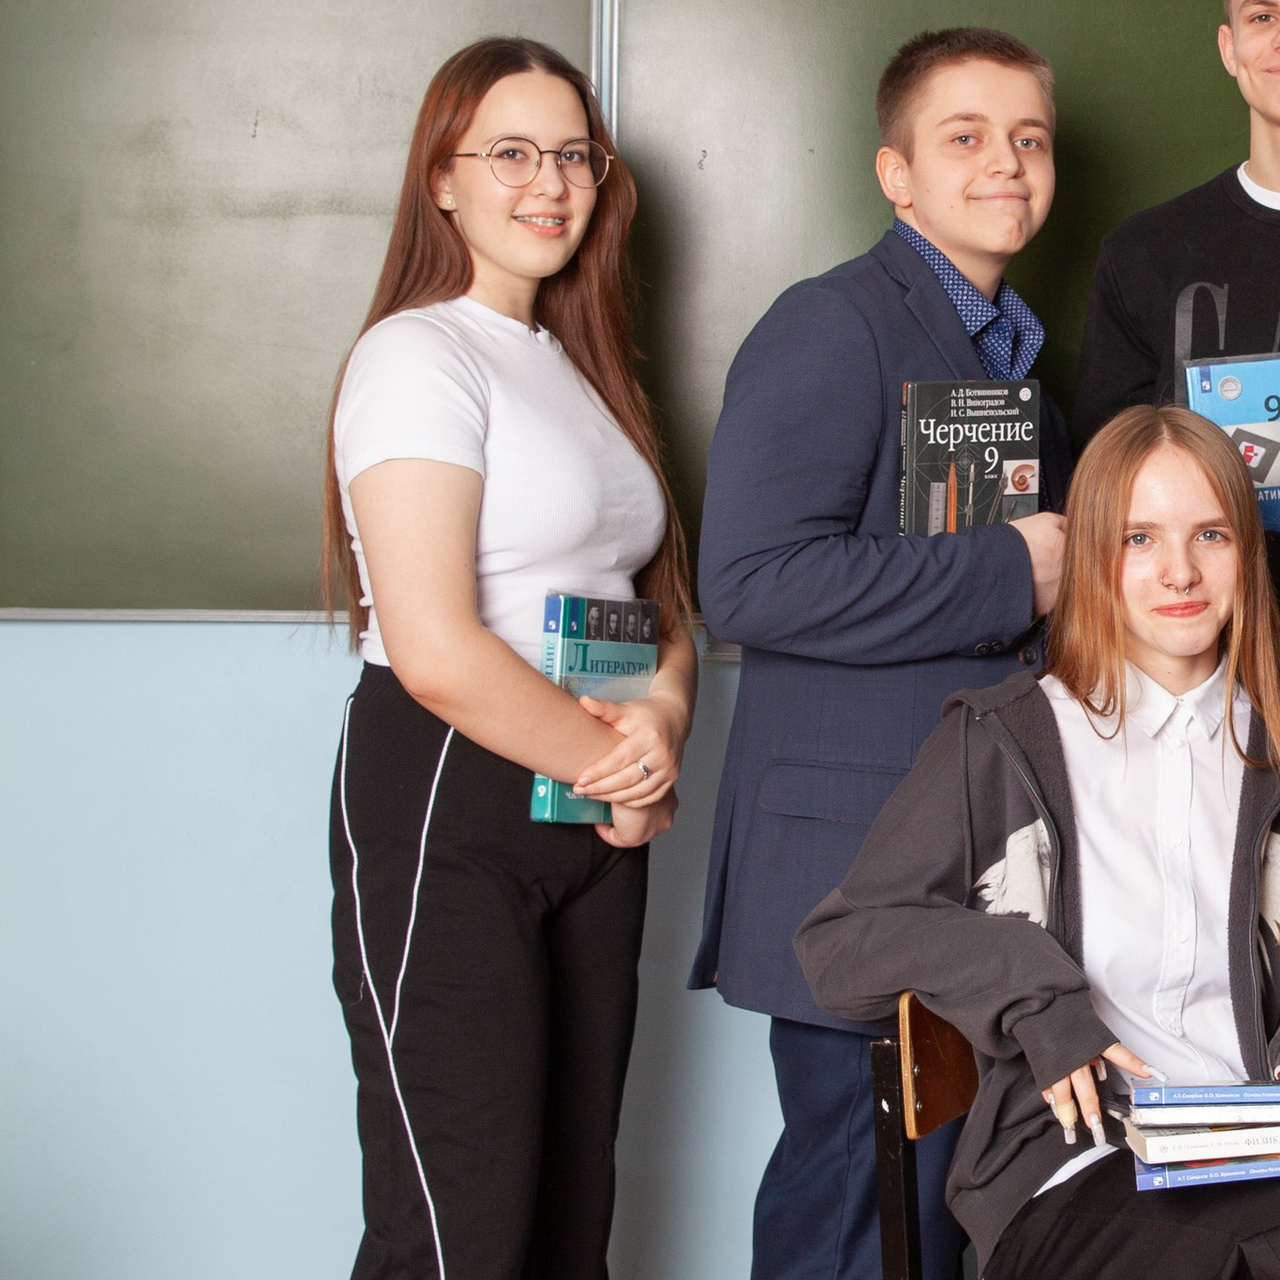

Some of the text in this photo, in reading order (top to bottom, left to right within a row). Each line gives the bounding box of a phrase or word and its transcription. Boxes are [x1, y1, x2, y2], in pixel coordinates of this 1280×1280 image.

[919, 418, 1033, 451] Черчение
[984, 446, 999, 473] 9
[537, 784, 547, 798] 9
